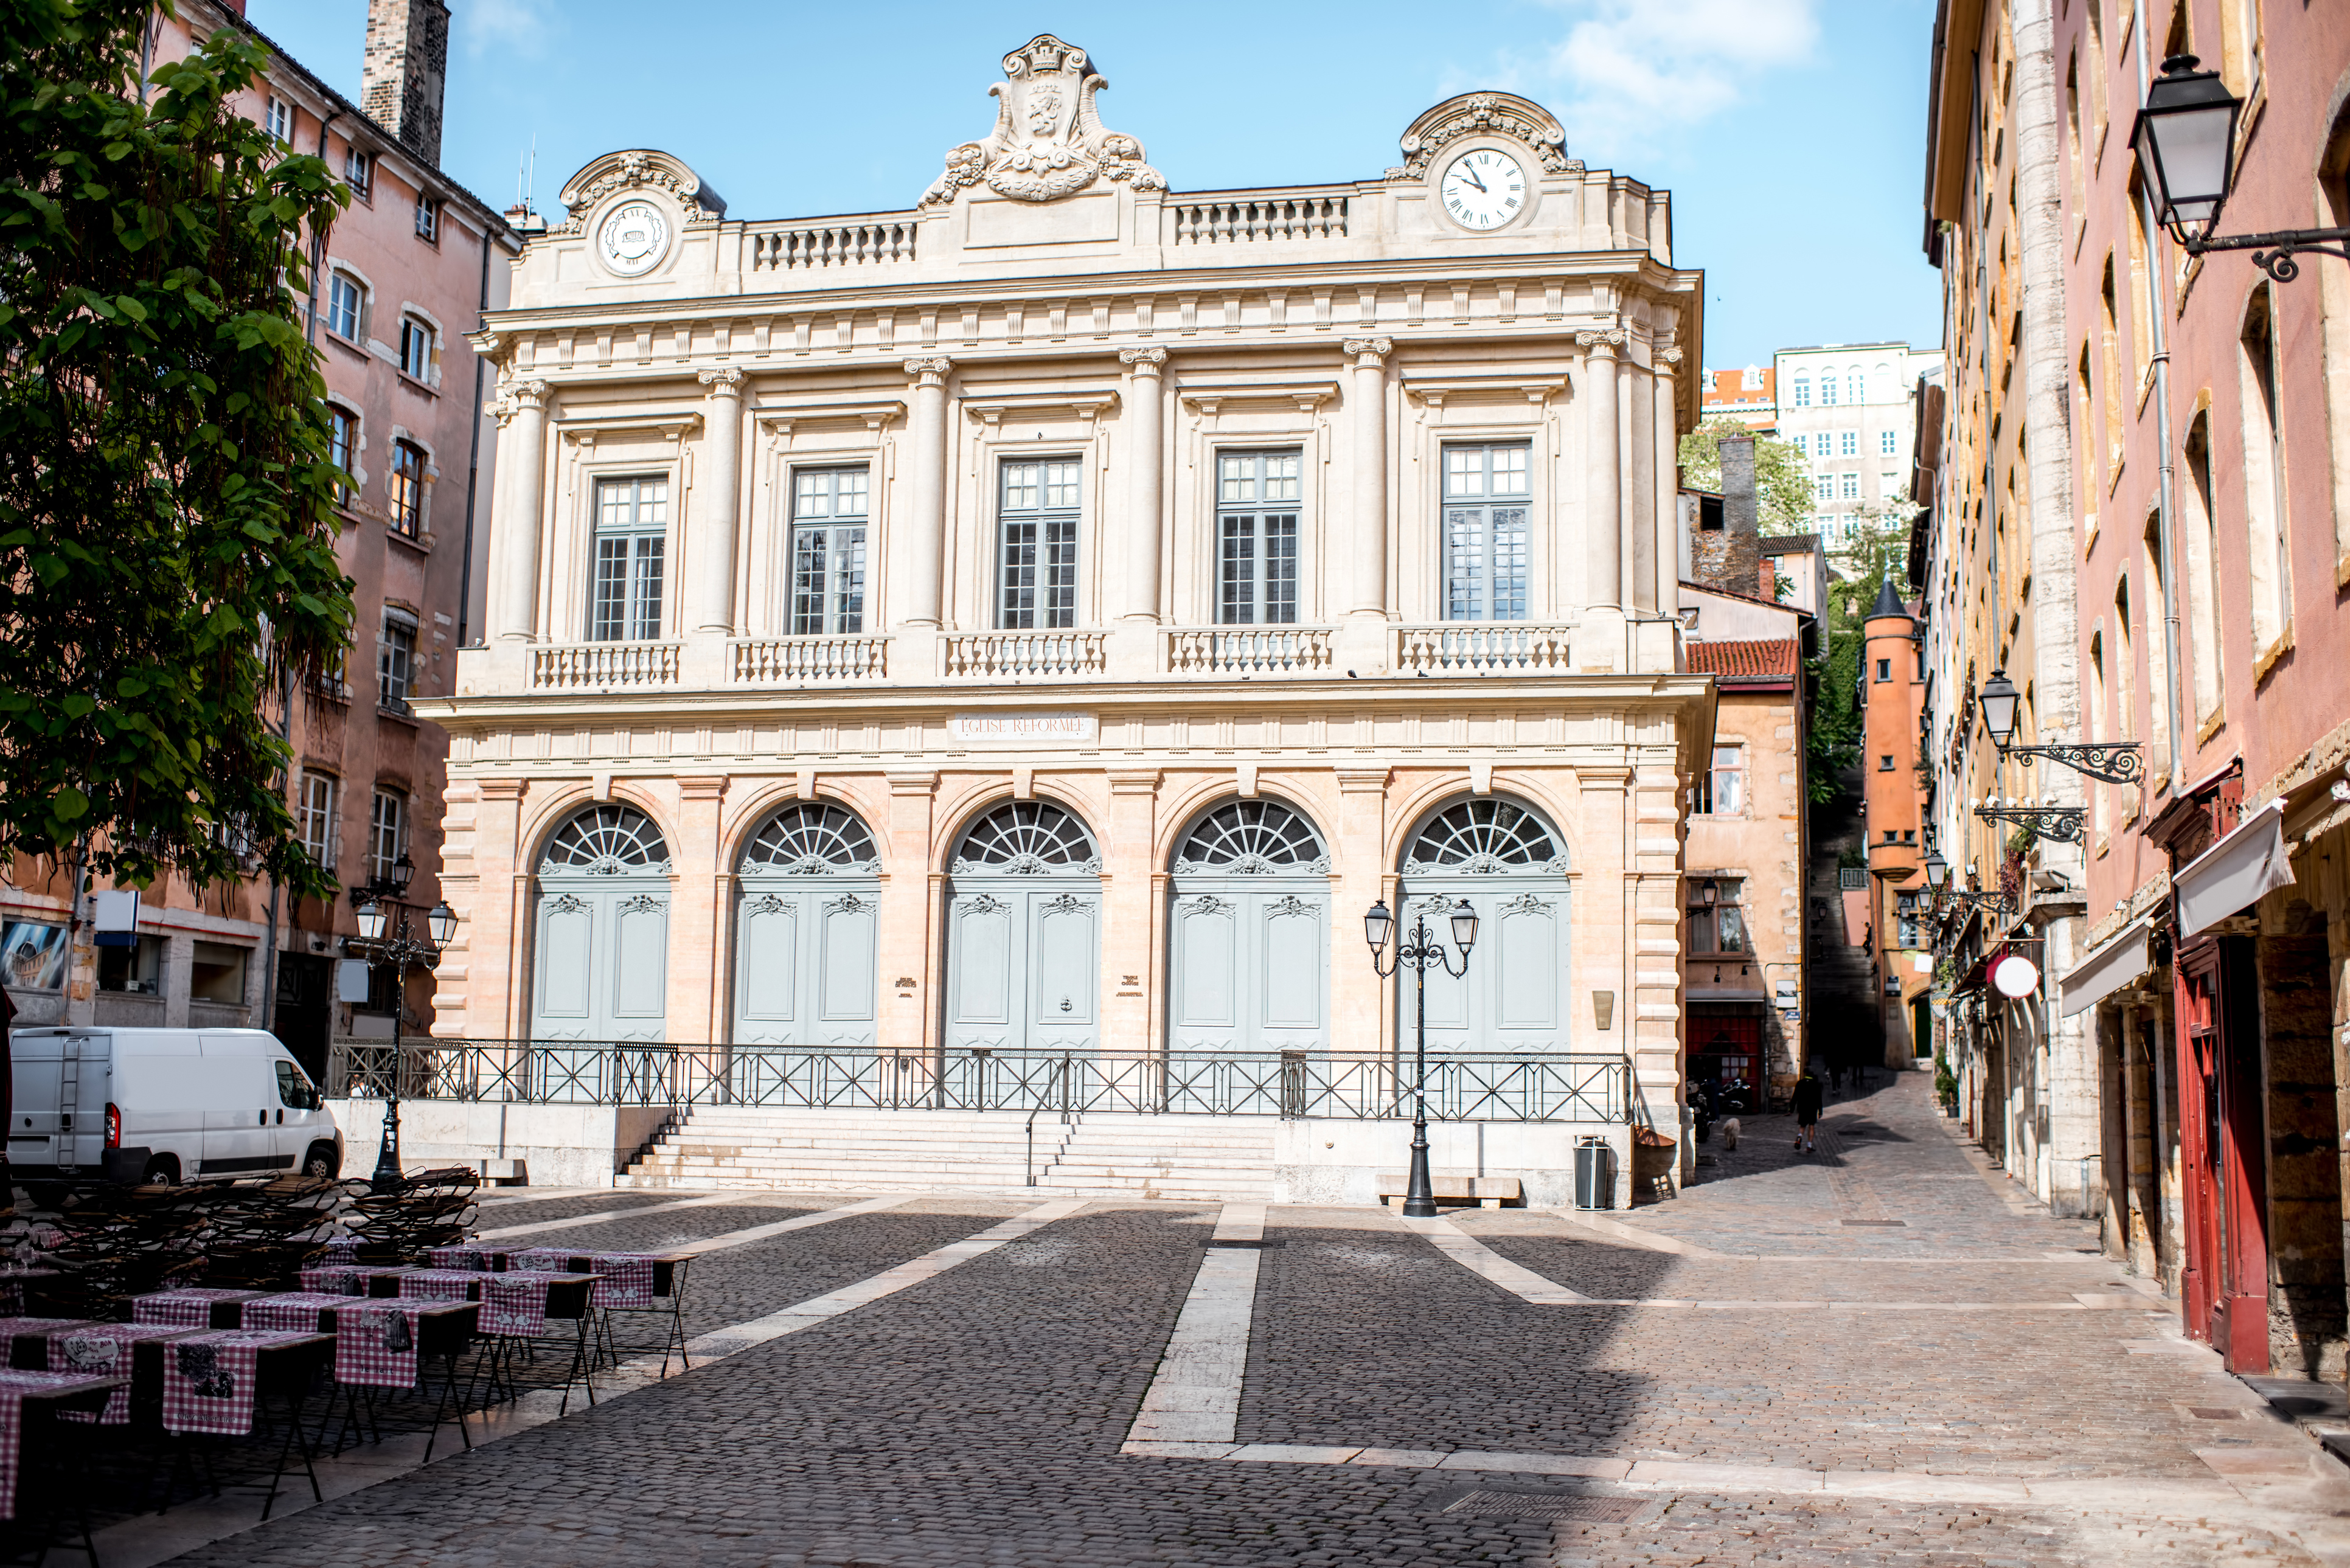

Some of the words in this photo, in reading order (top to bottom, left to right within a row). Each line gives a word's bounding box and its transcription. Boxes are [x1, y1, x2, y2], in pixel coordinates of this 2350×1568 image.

[1478, 154, 1489, 165] XII
[1497, 158, 1503, 167] I
[1462, 209, 1473, 222] VII
[1481, 213, 1489, 224] VI
[100, 1340, 112, 1348] BON
[375, 1365, 394, 1374] lait
[178, 1412, 195, 1421] Chez
